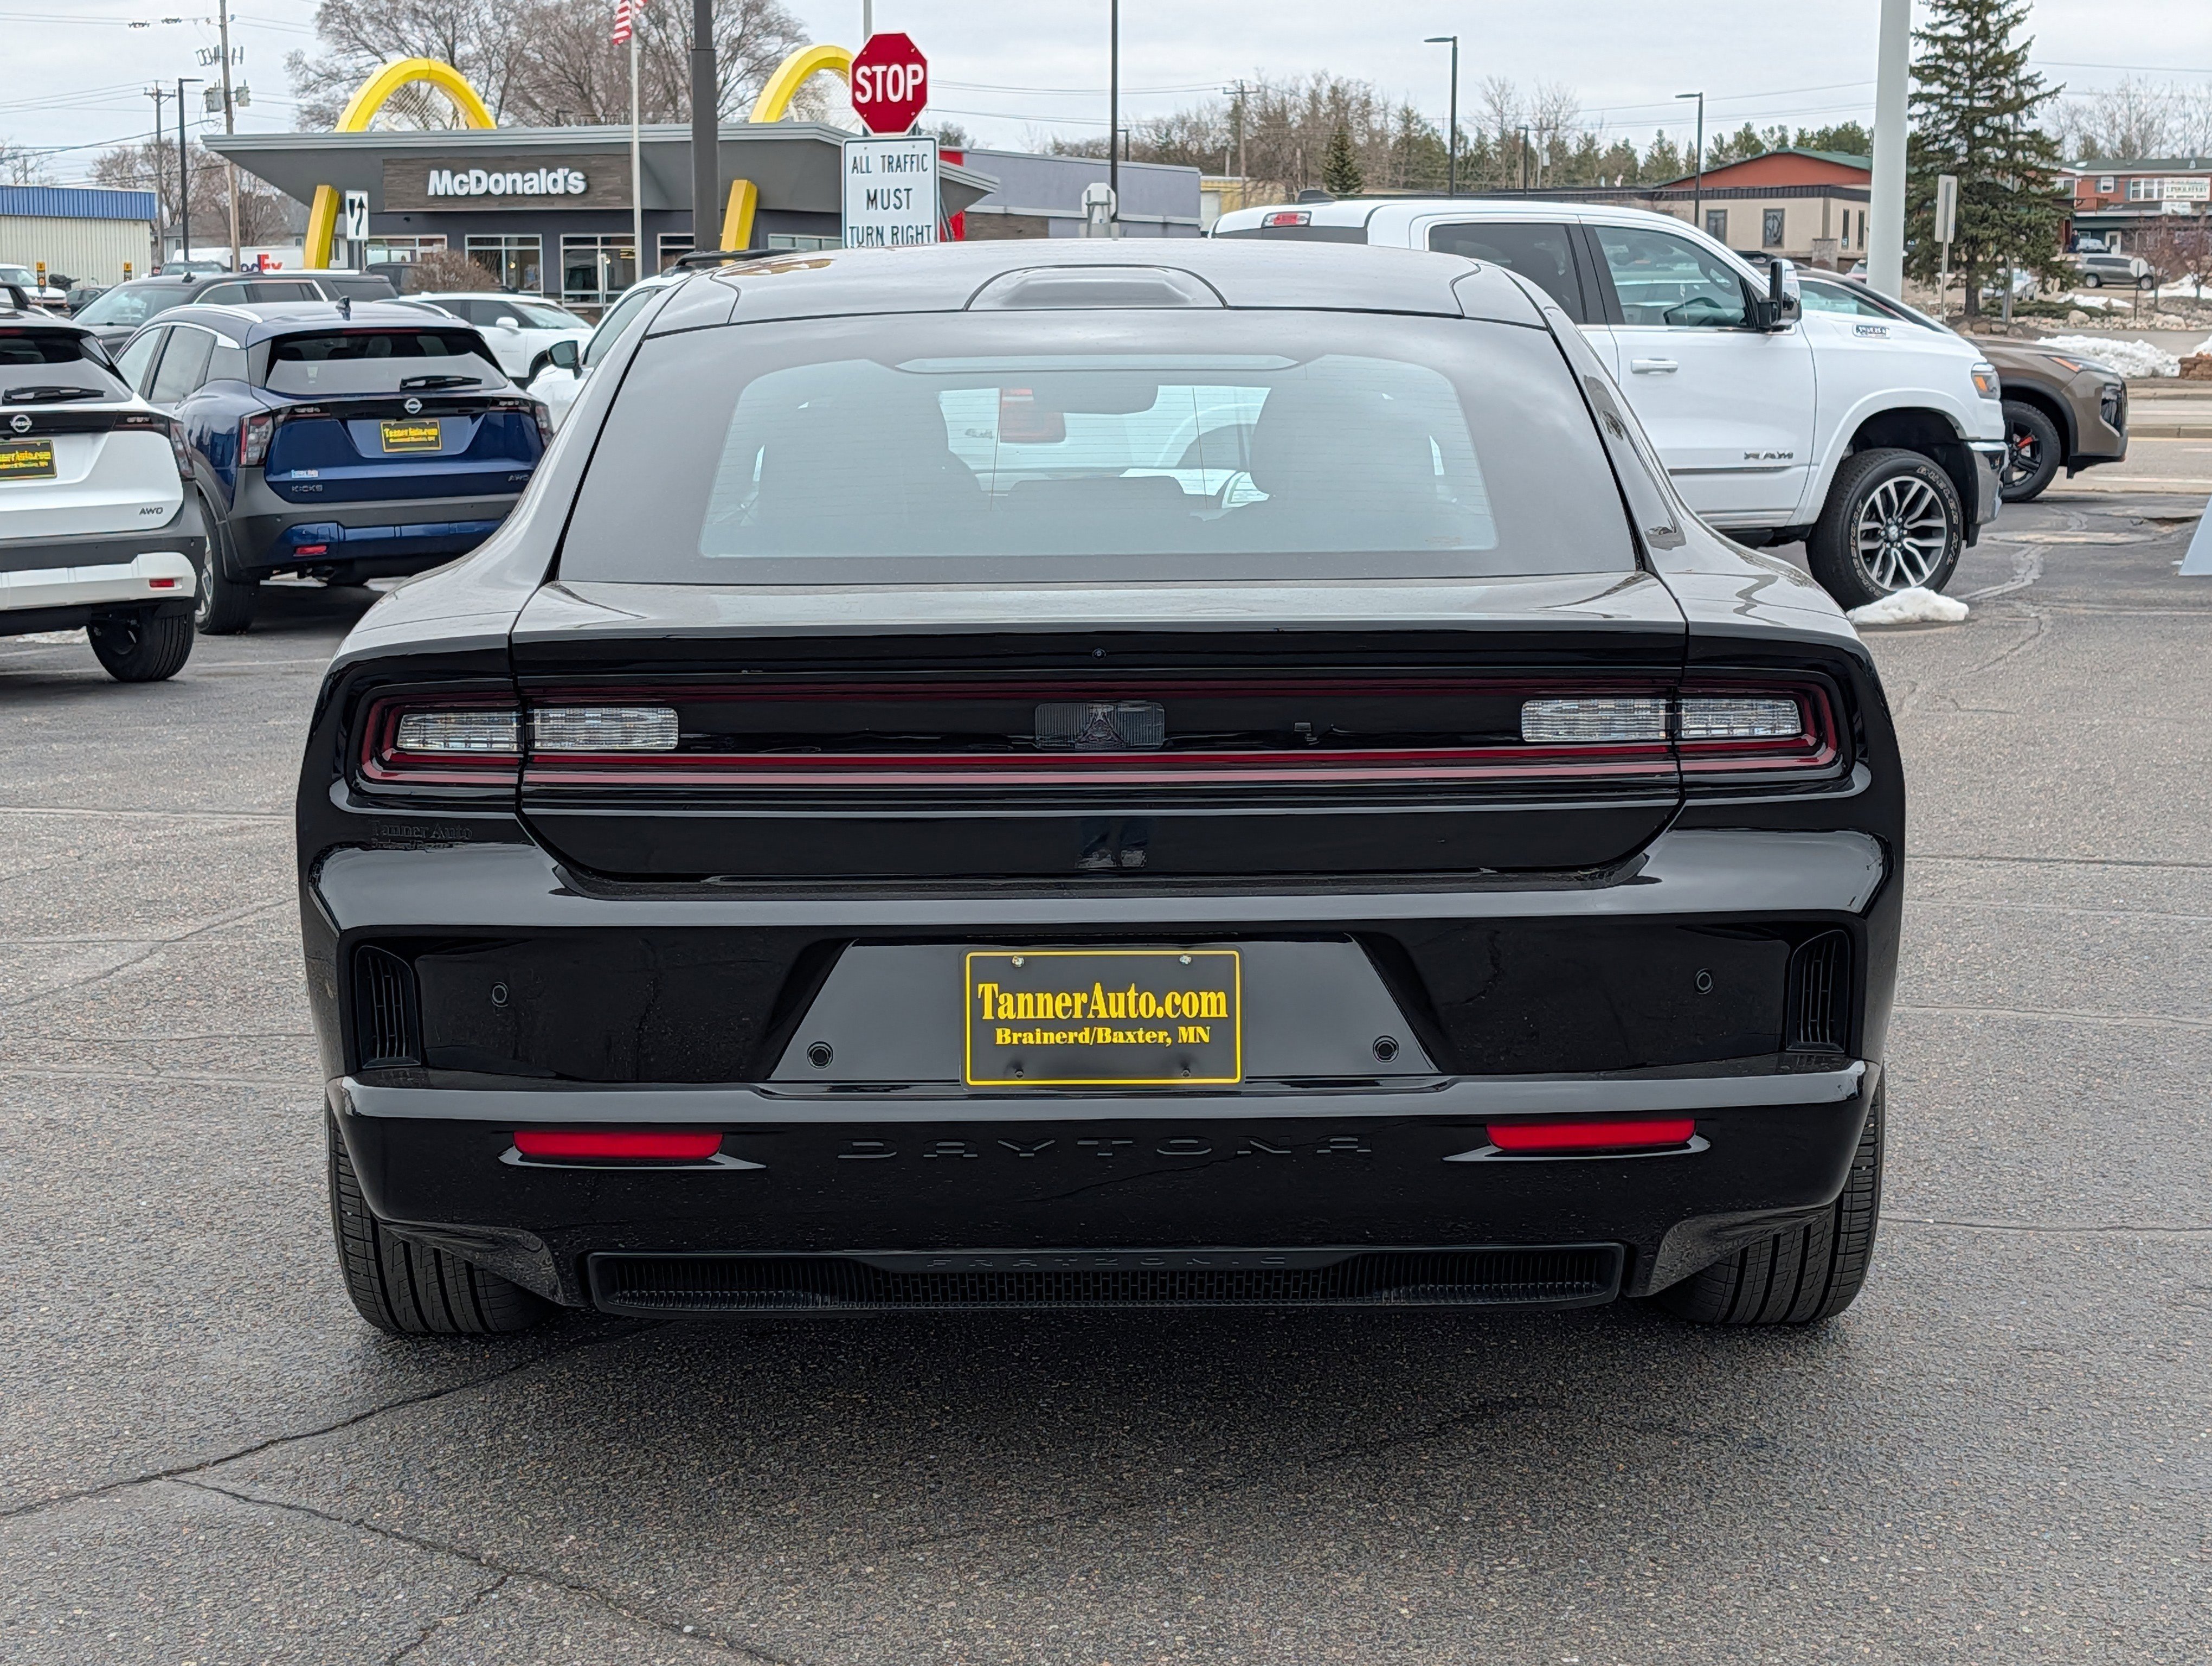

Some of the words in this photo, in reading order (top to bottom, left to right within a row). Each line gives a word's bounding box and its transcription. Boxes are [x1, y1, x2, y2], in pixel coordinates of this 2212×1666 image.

[854, 63, 924, 104] STOP
[851, 155, 872, 174] ALL
[880, 153, 928, 173] TRAFFIC
[427, 168, 588, 196] McDonald's
[866, 188, 913, 210] MUST
[848, 225, 885, 248] TURN
[891, 225, 932, 245] RIGHT
[978, 982, 1228, 1020] TannerAuto.com
[995, 1026, 1172, 1047] Brainerd/Baxter,
[1178, 1026, 1211, 1043] MN
[838, 1137, 1372, 1158] DAYTONA
